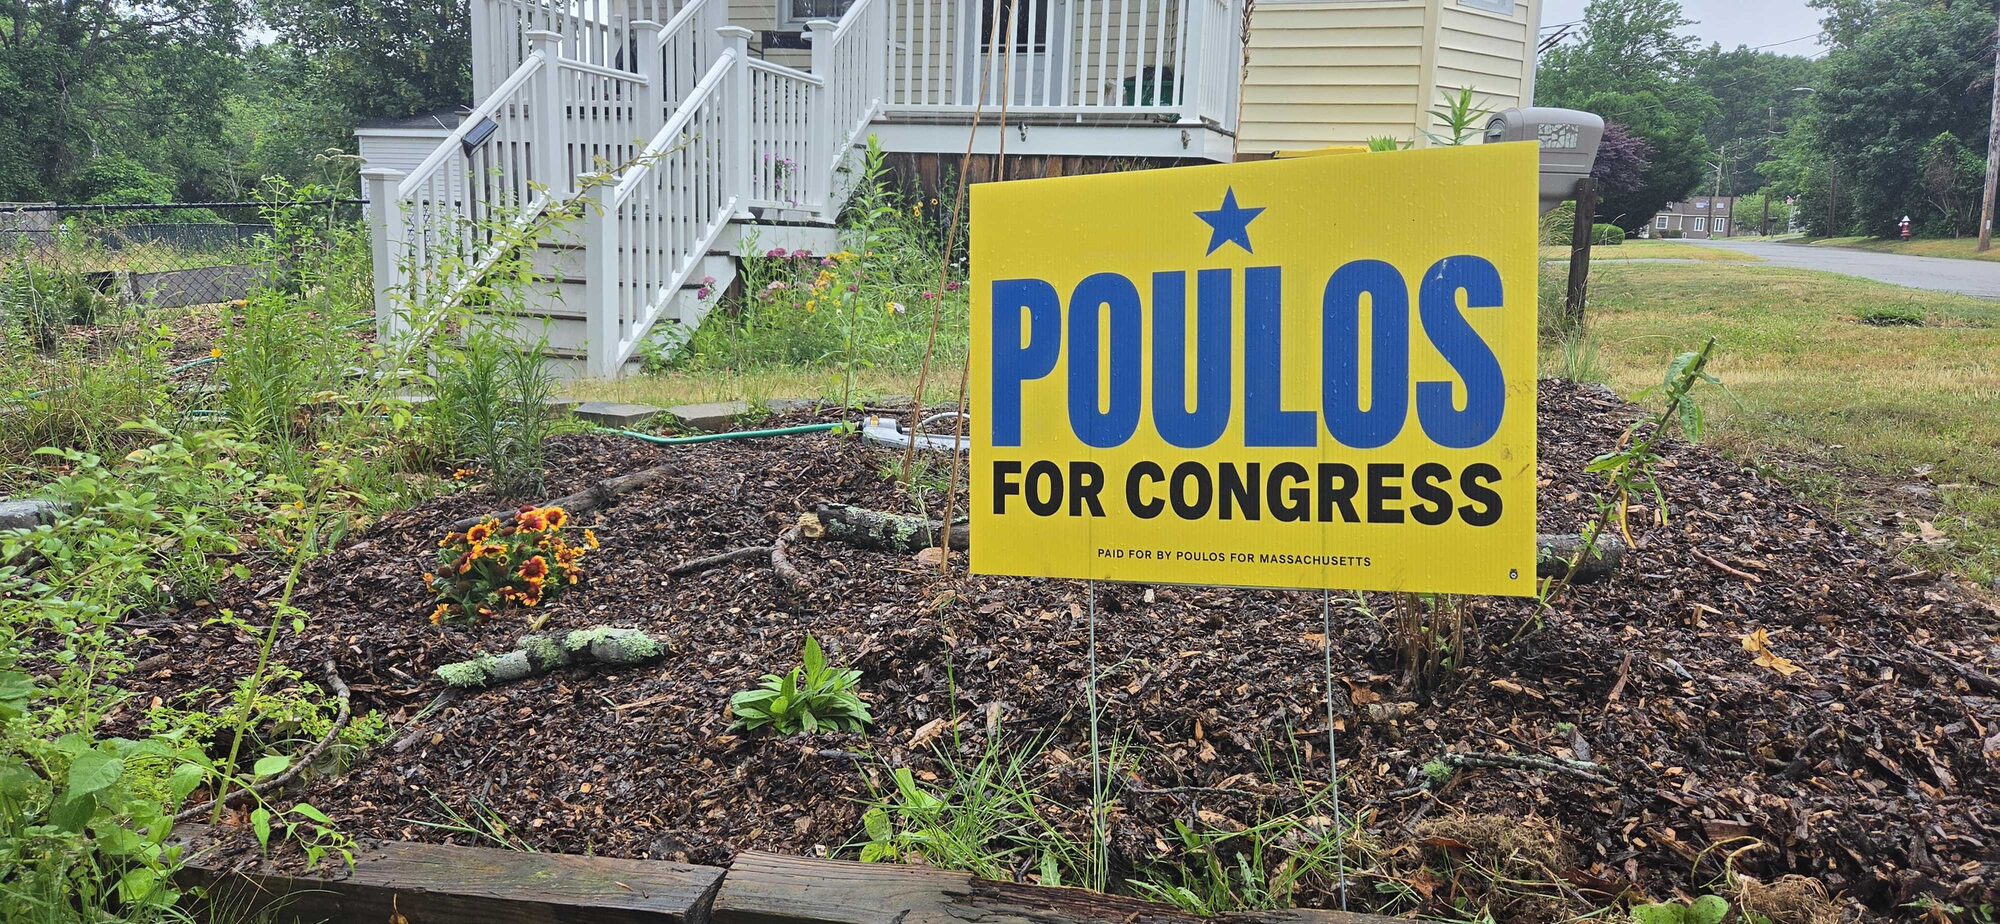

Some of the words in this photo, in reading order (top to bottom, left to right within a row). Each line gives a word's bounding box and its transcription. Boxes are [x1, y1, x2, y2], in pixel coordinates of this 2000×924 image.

[992, 255, 1505, 449] POULOS
[993, 460, 1106, 518] FOR
[1125, 460, 1503, 527] CONGRESS
[1097, 548, 1124, 559] PAID
[1128, 549, 1152, 560] FOR
[1156, 550, 1172, 560] BY
[1176, 551, 1226, 562] POULOS
[1230, 552, 1255, 563] FOR
[1259, 553, 1371, 567] MASSACHUSETTS
